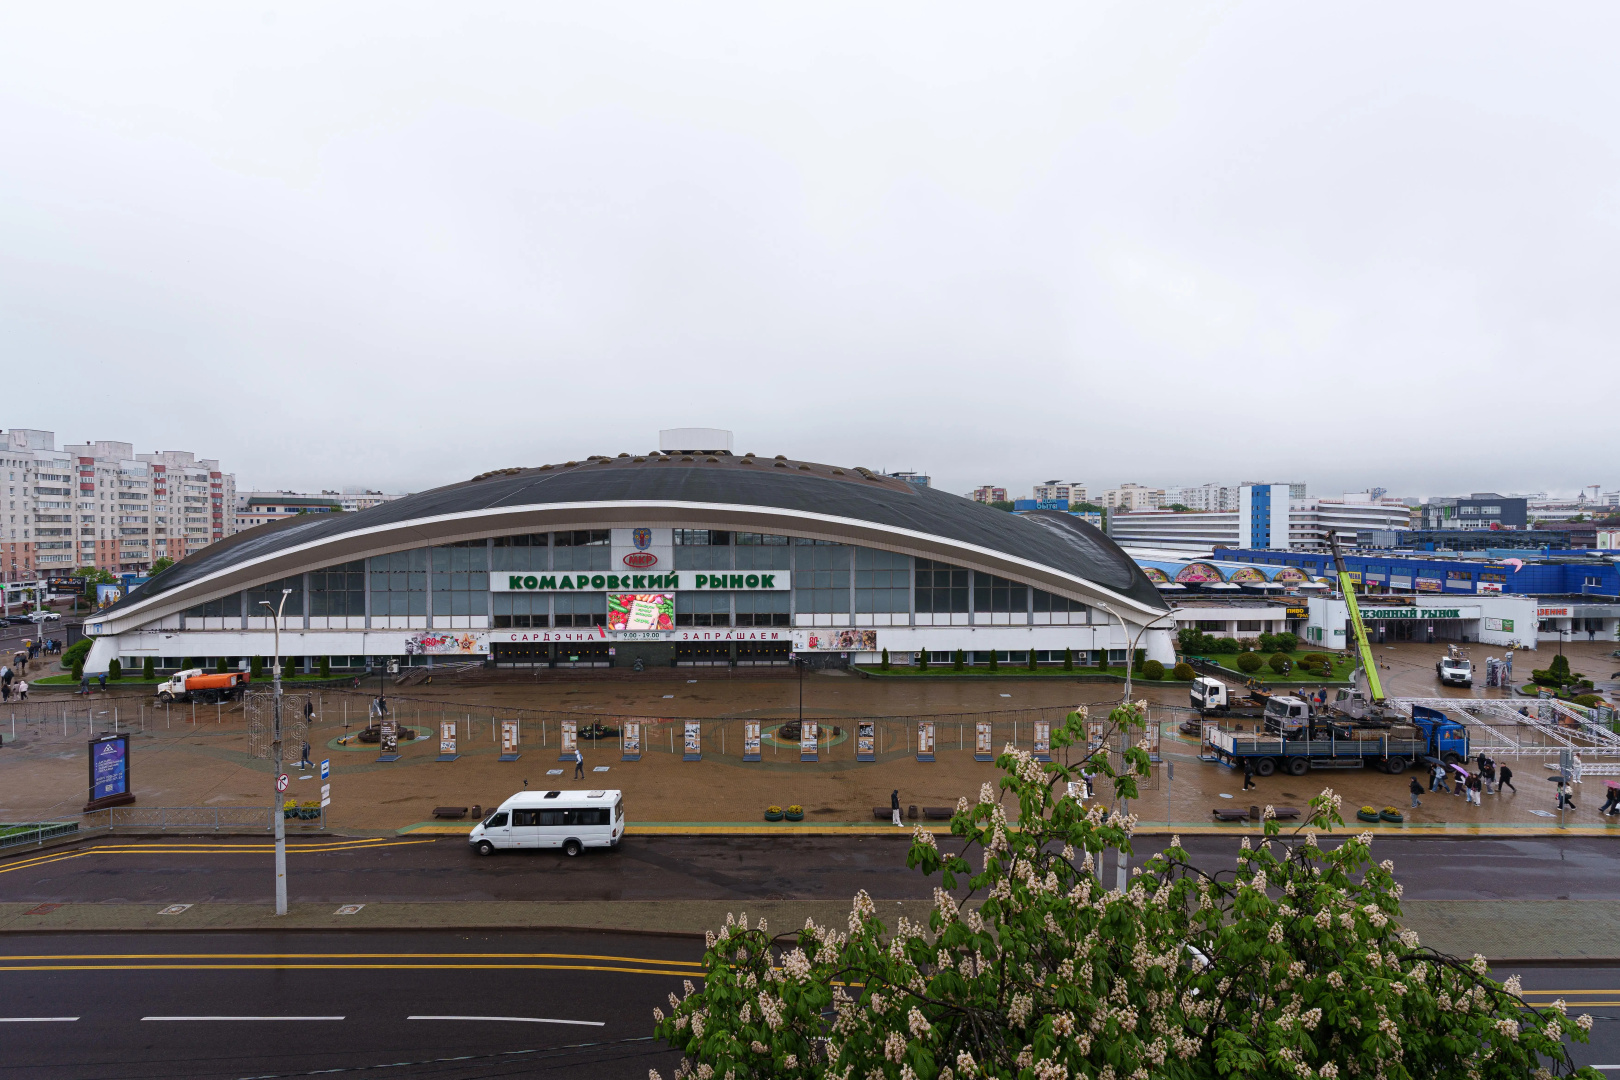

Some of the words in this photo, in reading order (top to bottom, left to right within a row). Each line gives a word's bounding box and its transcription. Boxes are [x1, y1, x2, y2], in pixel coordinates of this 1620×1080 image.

[628, 555, 652, 564] МКР
[509, 570, 679, 590] КОМАРОВСКИЙ
[695, 574, 775, 589] РЫНОК
[1358, 607, 1418, 619] ЕЗОННЫЙ
[1421, 609, 1460, 618] РЫНОК
[425, 637, 436, 647] 80
[511, 632, 594, 642] САРДЭЧНА
[682, 632, 779, 641] ЗАПРАШАЕМ
